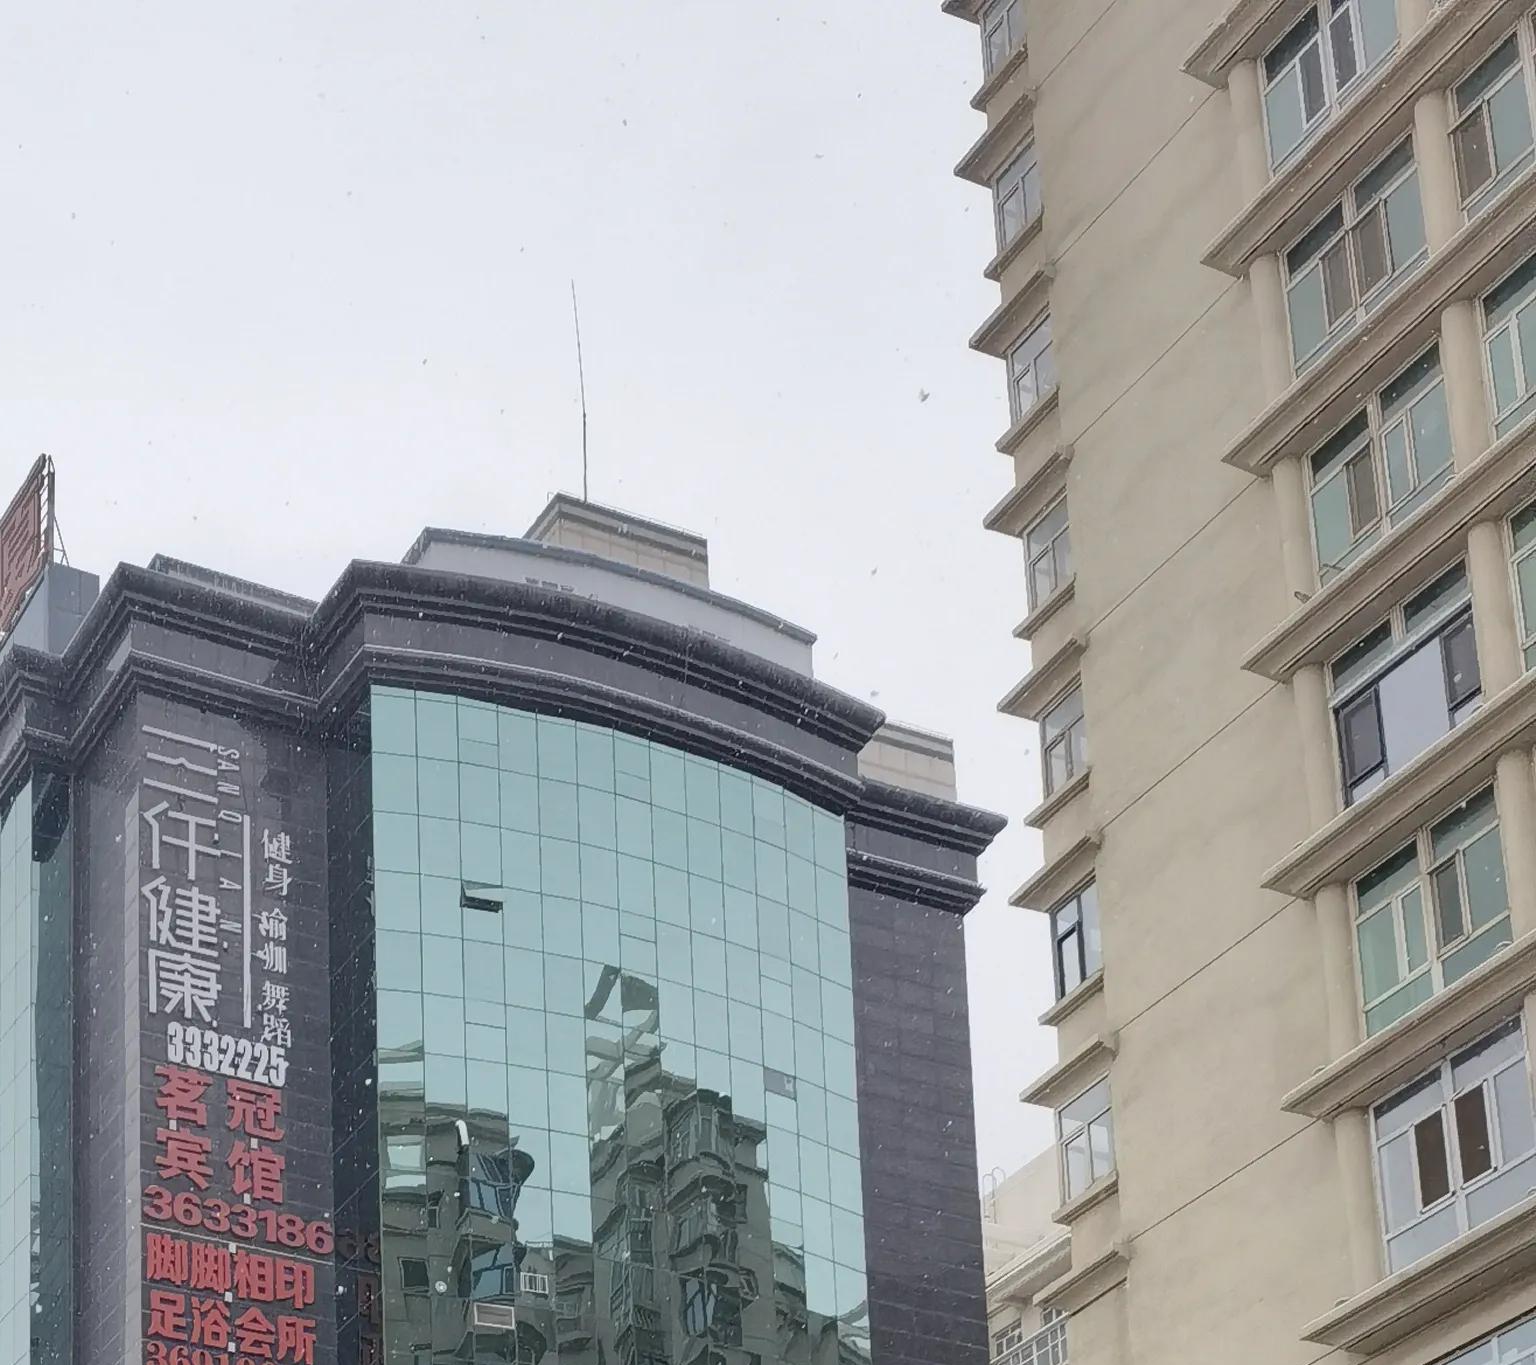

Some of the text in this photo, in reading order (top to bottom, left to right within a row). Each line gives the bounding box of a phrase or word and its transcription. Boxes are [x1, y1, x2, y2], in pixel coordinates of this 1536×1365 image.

[261, 828, 293, 896] 健身
[261, 979, 292, 1048] 舞蹈
[167, 1021, 289, 1087] 3332225
[143, 1184, 335, 1255] 3633186
[146, 1232, 315, 1310] 脚脚相印
